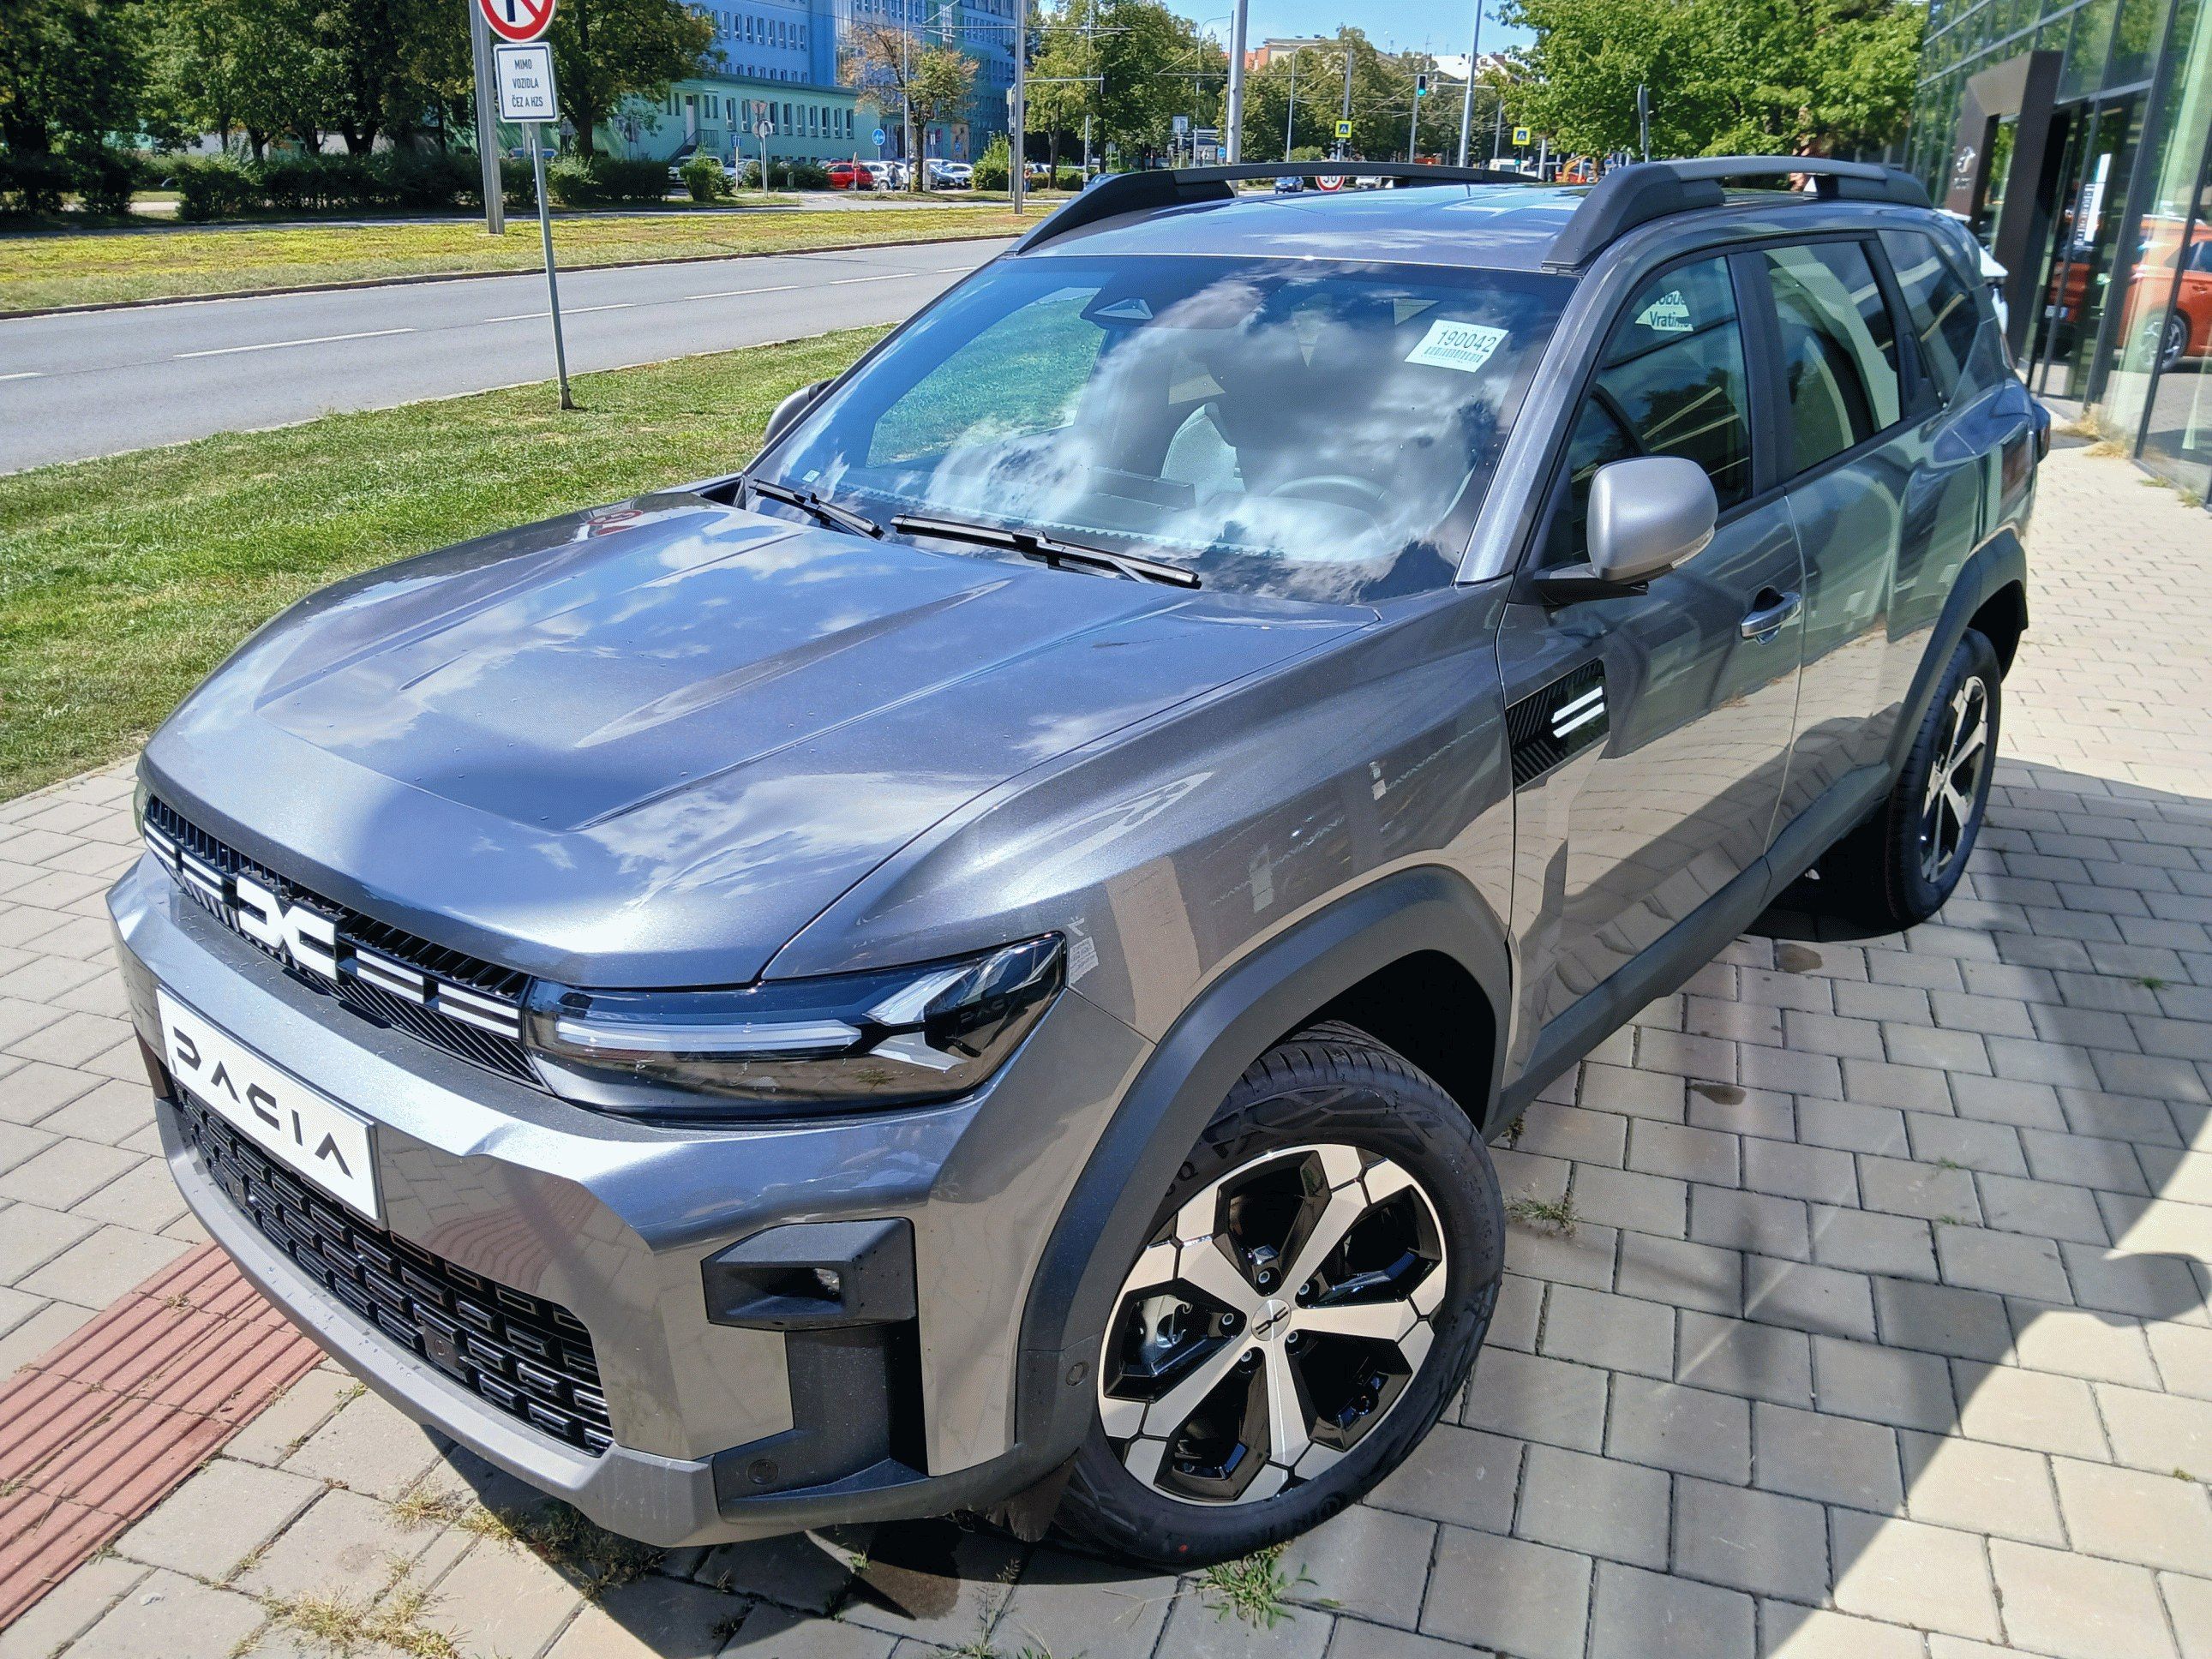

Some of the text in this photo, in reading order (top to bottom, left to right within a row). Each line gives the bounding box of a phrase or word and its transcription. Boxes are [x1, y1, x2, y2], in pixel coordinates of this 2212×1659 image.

[514, 58, 532, 70] MIMO
[513, 77, 539, 89] VOZIDLA
[512, 94, 543, 108] ČEZ A HZS
[1436, 329, 1497, 353] 190042
[171, 1025, 354, 1180] DACIA
